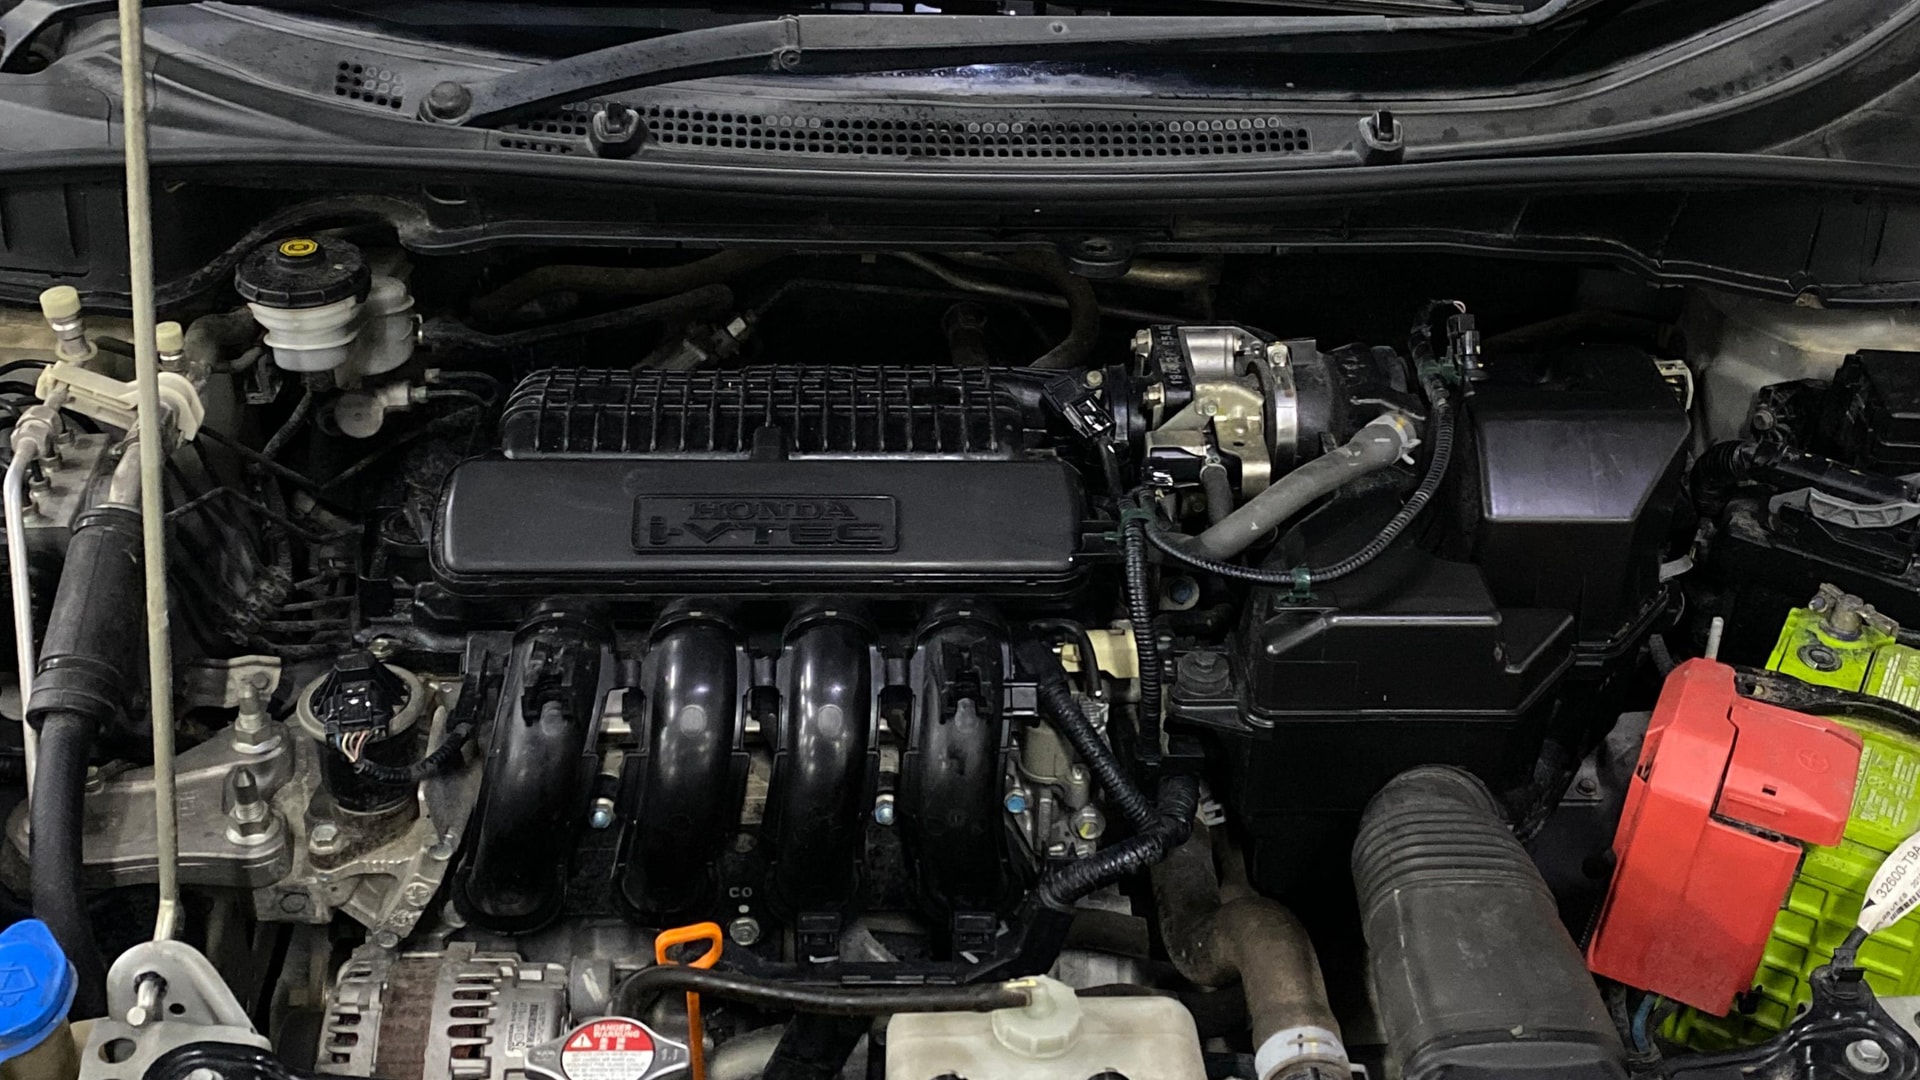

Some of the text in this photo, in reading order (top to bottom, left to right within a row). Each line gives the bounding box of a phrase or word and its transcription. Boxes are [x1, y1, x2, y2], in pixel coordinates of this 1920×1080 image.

[688, 501, 858, 520] HONDA
[649, 515, 883, 545] i-VTEC
[593, 1023, 632, 1031] DANGER
